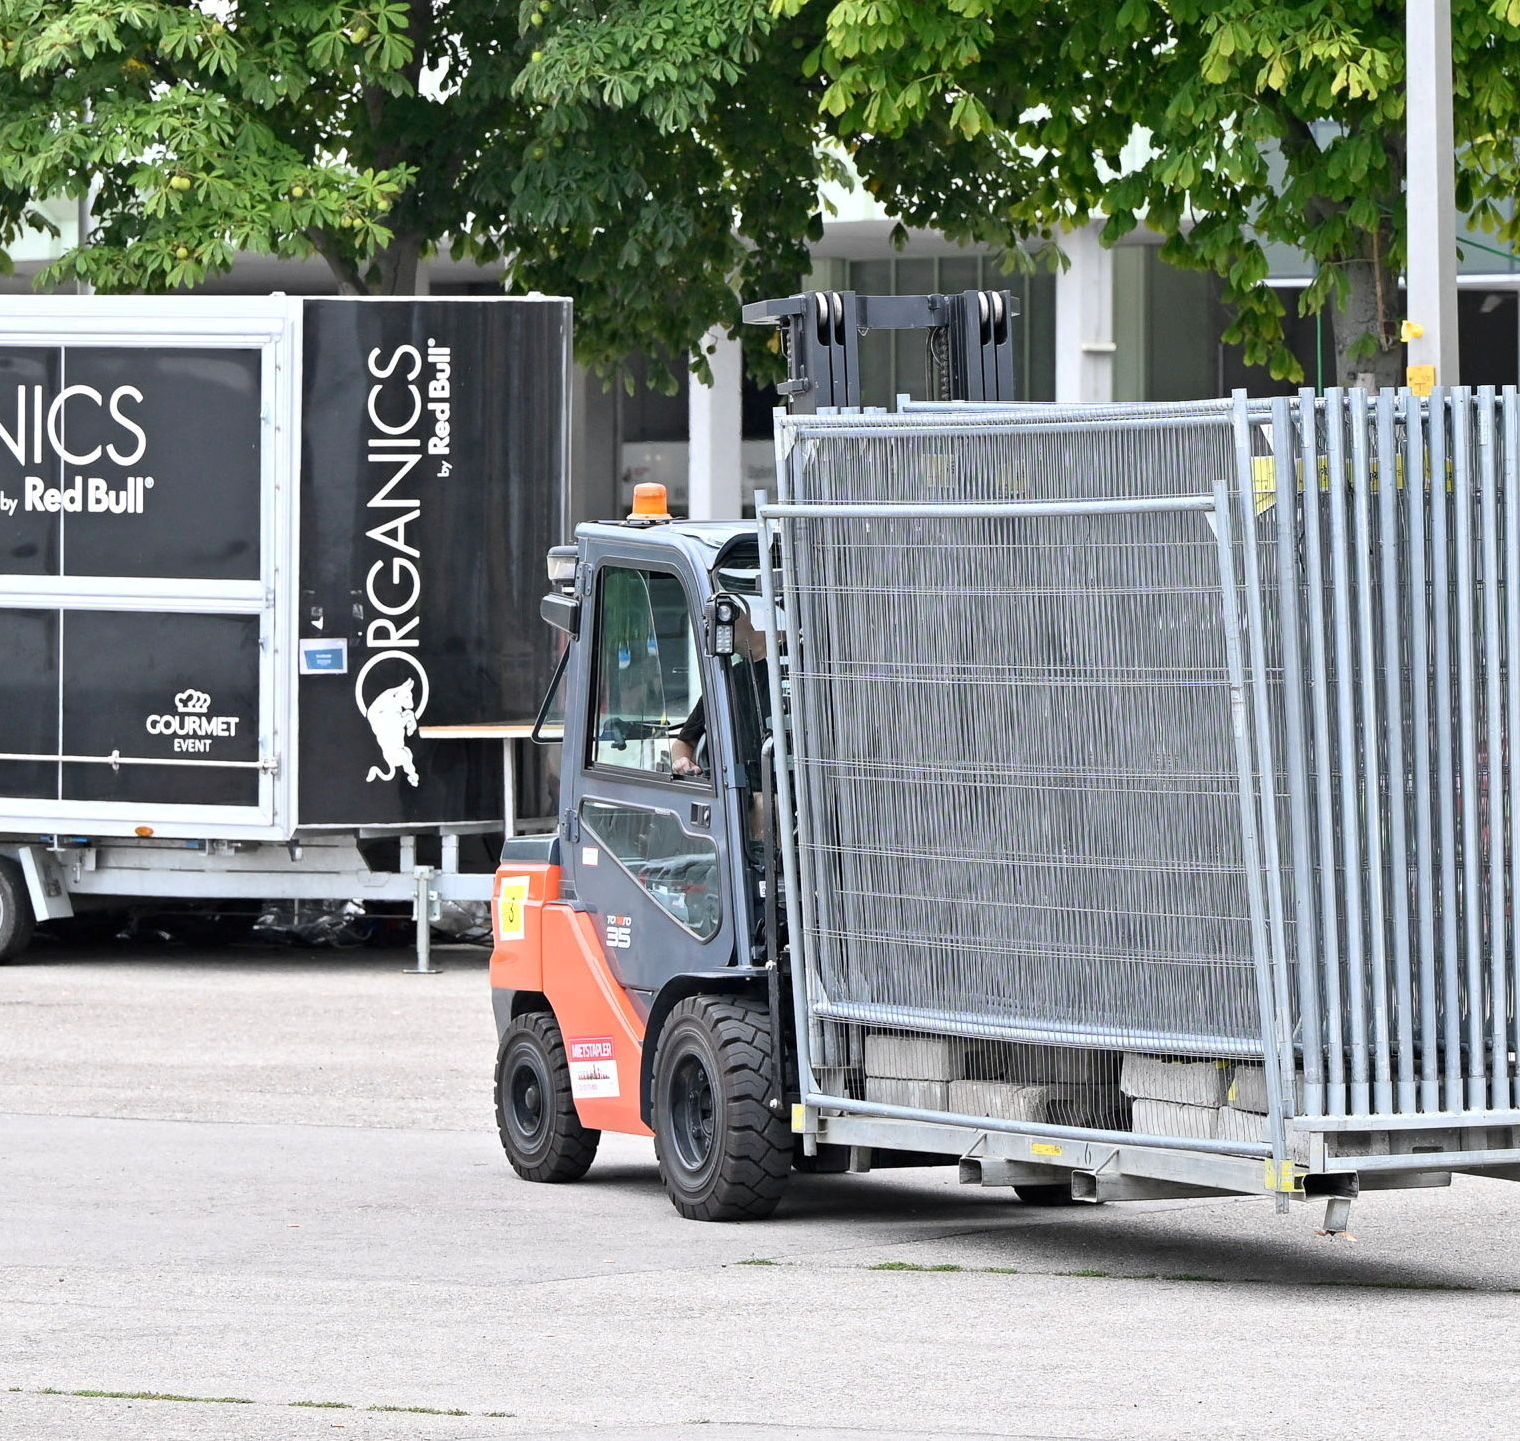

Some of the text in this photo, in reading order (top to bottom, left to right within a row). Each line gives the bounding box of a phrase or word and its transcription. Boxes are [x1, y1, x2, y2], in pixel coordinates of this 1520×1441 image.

[427, 402, 451, 455] Red
[436, 460, 453, 478] by
[0, 475, 144, 516] by Red Bull
[355, 344, 429, 721] ORGANICS
[146, 714, 240, 737] GOURMET
[174, 739, 213, 752] EVENT
[606, 926, 631, 948] 35
